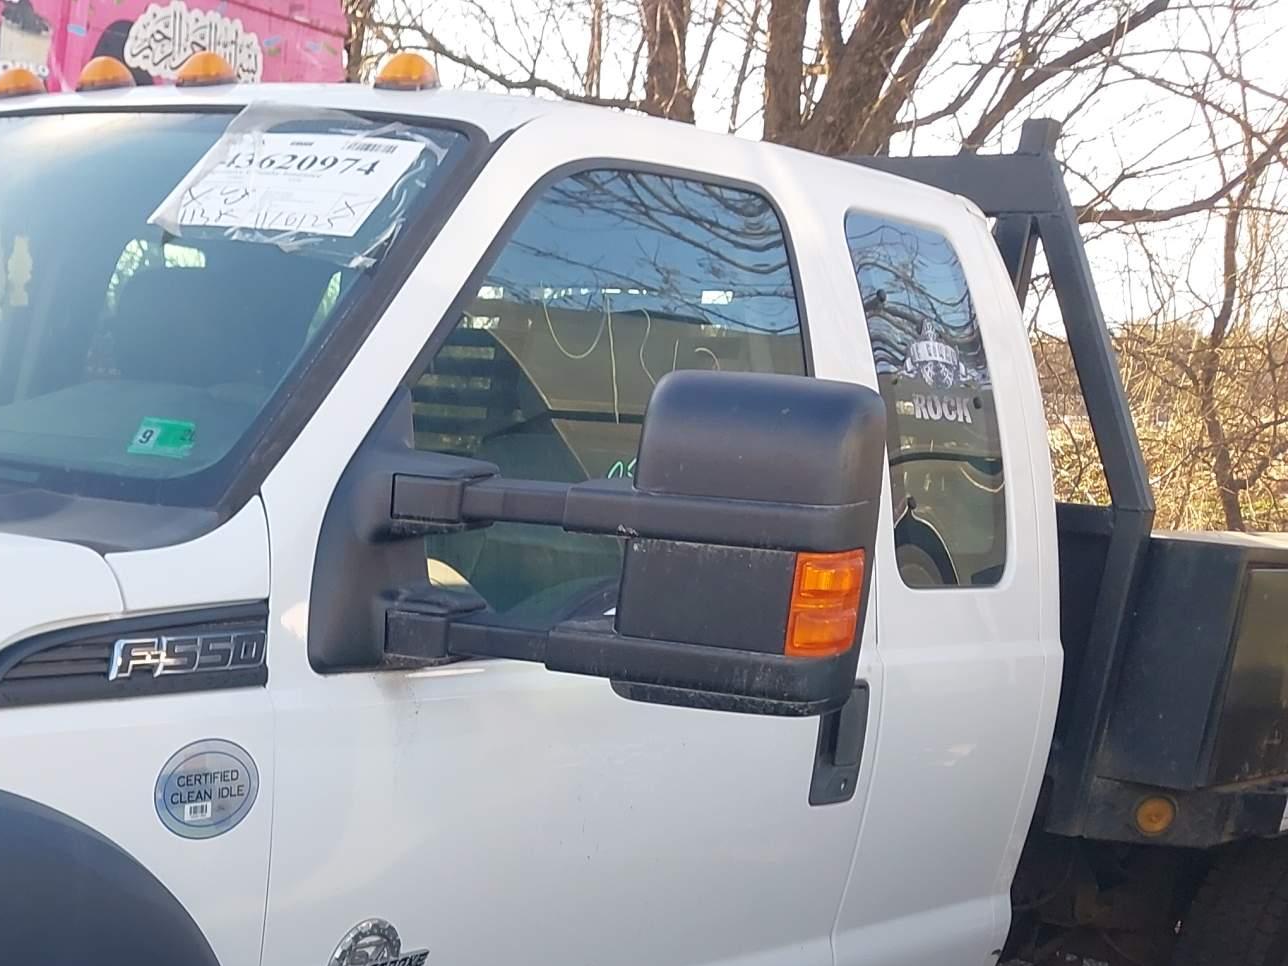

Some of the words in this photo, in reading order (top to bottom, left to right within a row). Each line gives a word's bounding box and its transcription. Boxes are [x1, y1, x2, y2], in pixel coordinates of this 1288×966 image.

[913, 393, 972, 423] ROCK
[176, 769, 239, 788] CERTIFIED
[170, 788, 212, 805] CLEAN
[218, 784, 245, 799] IDLE
